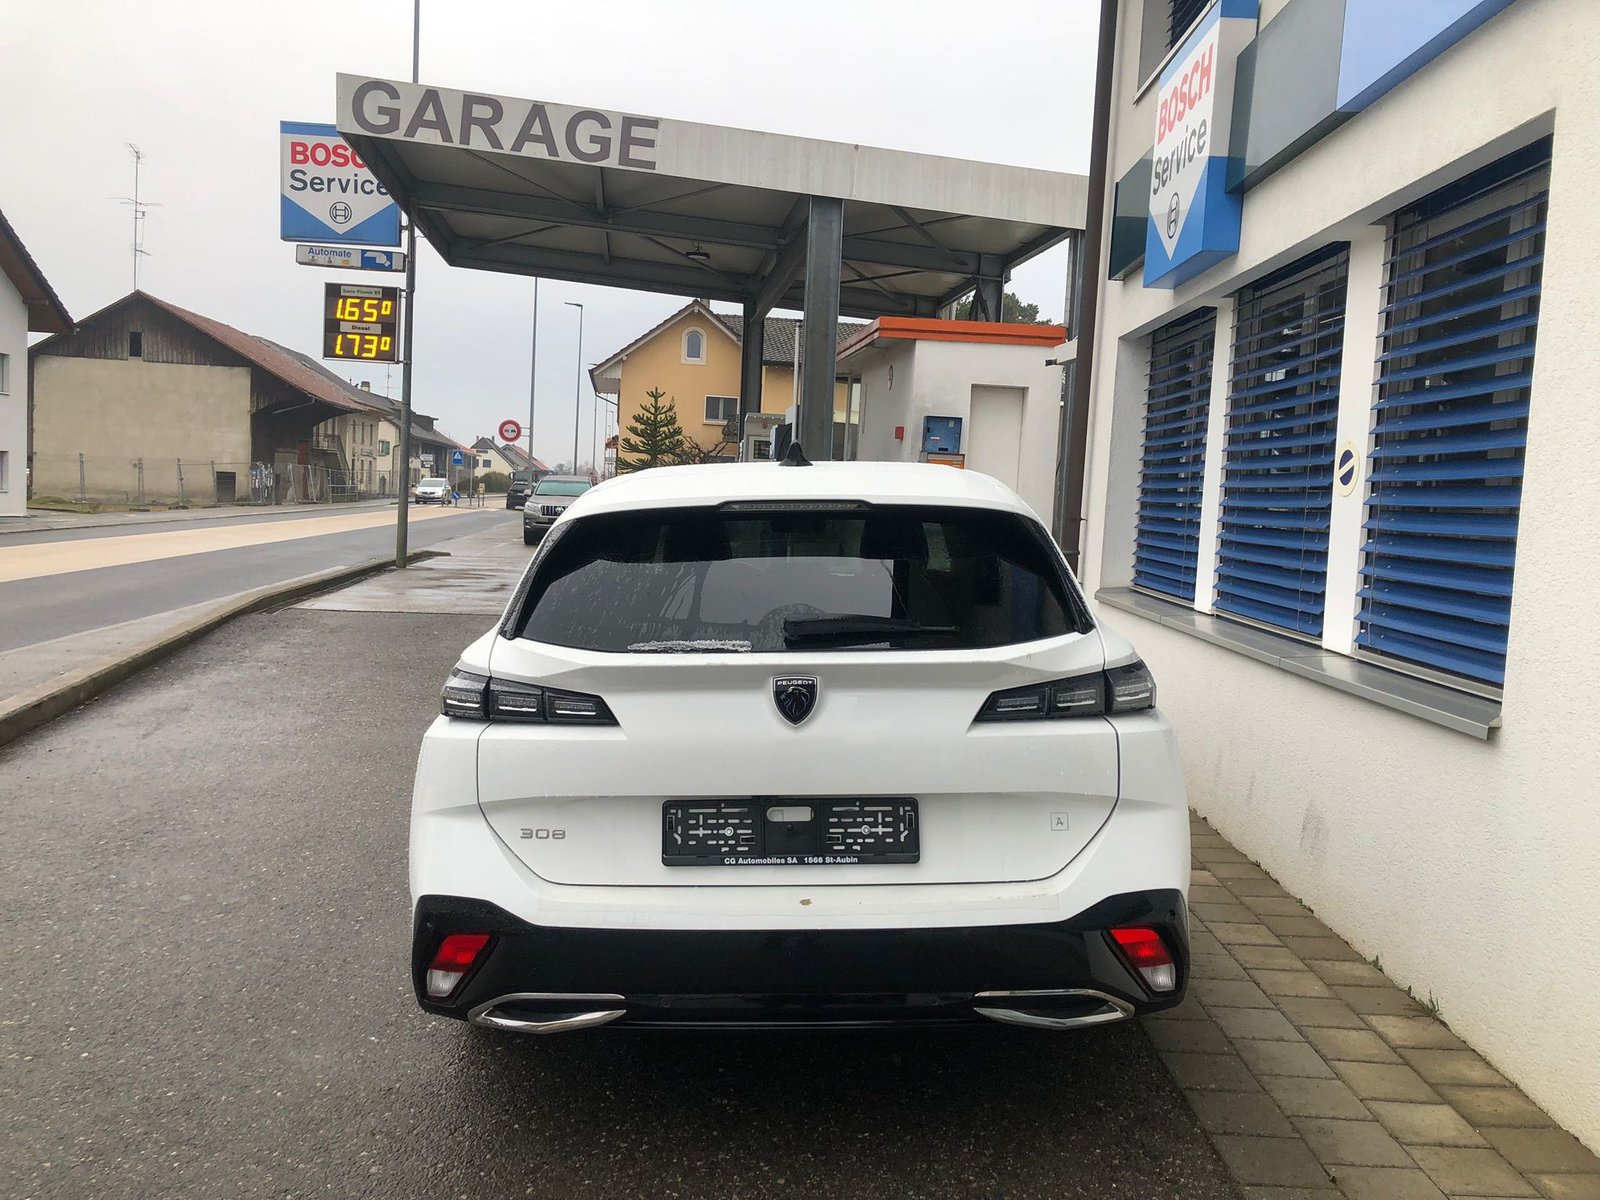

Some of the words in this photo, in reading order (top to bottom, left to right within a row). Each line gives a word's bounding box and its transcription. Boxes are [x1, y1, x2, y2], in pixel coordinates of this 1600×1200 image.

[1158, 43, 1214, 145] BOSCH
[352, 80, 659, 170] GARAGE
[291, 142, 366, 168] BOSC
[1153, 119, 1207, 195] Service
[308, 247, 352, 258] Automate
[520, 828, 566, 839] 308
